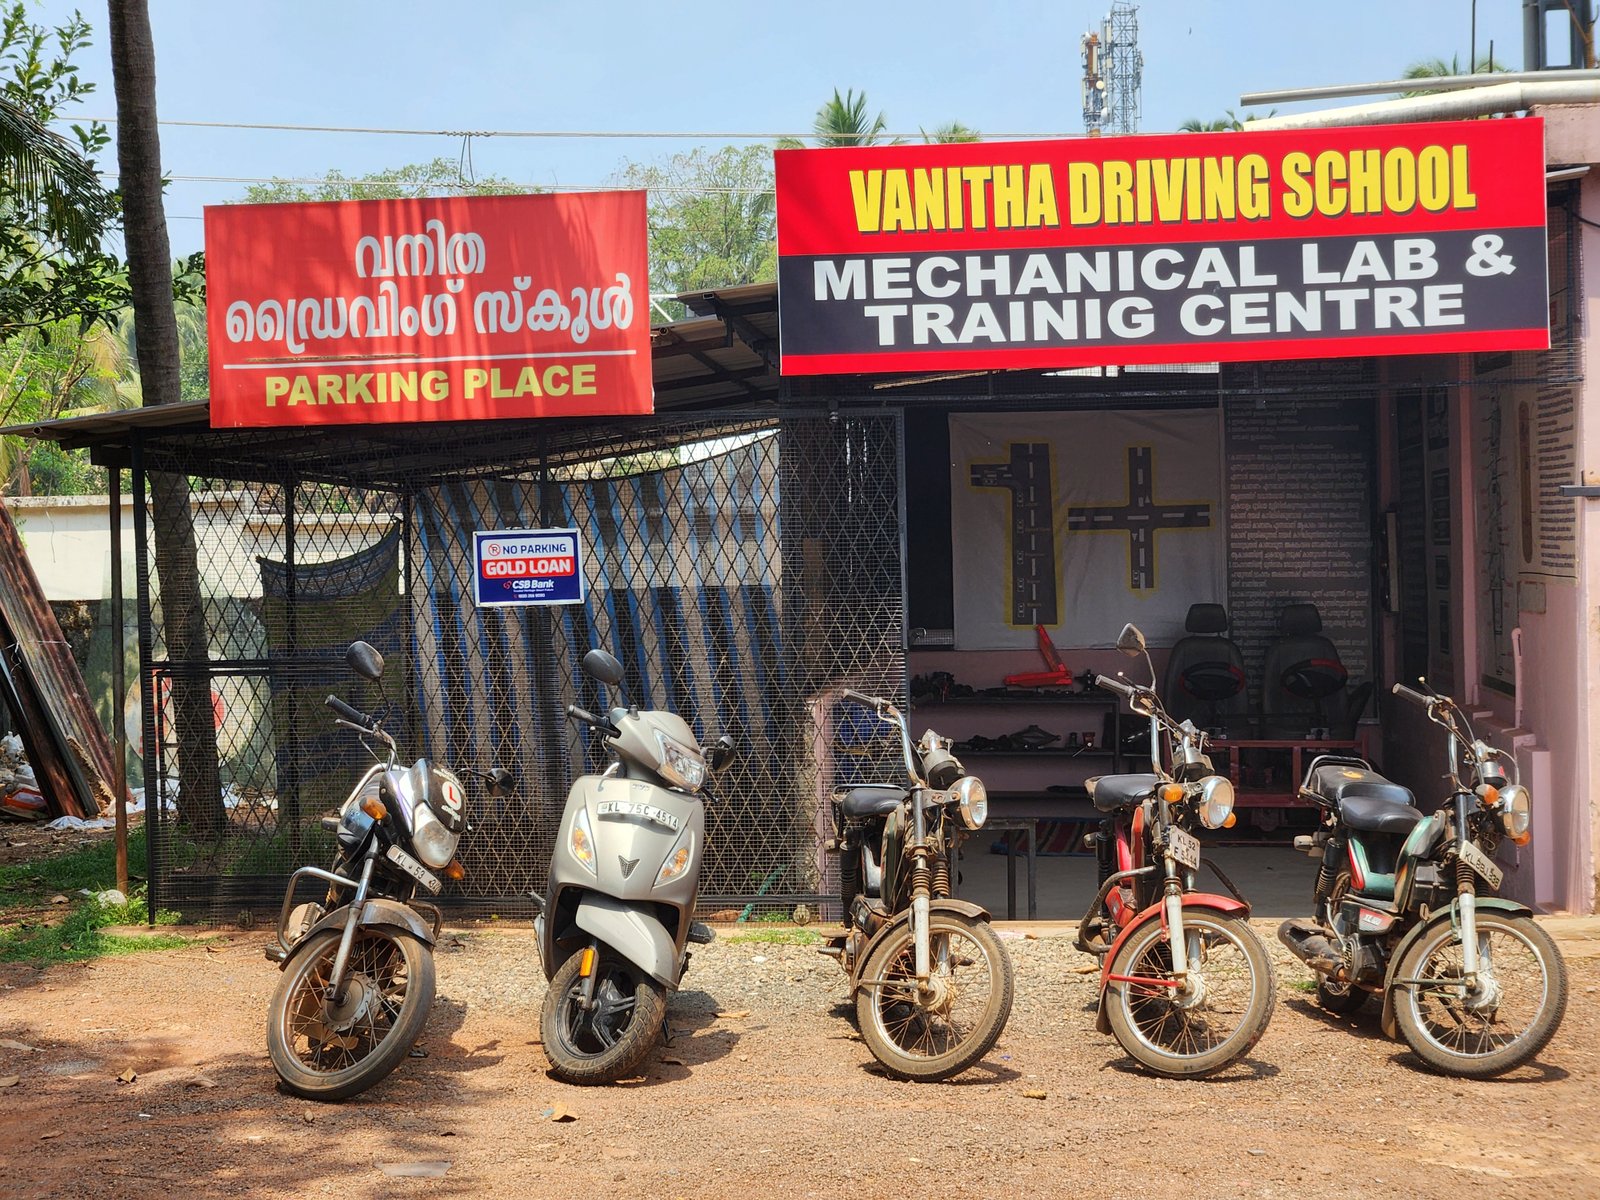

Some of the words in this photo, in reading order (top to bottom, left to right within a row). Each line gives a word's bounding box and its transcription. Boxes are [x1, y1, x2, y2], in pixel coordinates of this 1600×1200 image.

[849, 163, 1060, 234] VANITHA
[1068, 154, 1272, 226] DRIVING
[1281, 145, 1478, 219] SCHOOL
[355, 219, 487, 279] വനിത
[814, 246, 1278, 302] MECHANICAL
[1302, 239, 1439, 285] LAB
[1465, 234, 1518, 278] &
[473, 273, 635, 345] സ്കൂൾ
[863, 297, 1156, 348] TRAINIG
[1179, 284, 1466, 337] CENTRE
[265, 370, 450, 408] PARKING
[463, 364, 598, 400] PLACE
[485, 560, 527, 576] GOLD
[529, 558, 571, 575] LOAN
[502, 545, 518, 555] NO
[520, 543, 567, 554] PARKING
[512, 580, 531, 589] CSB
[531, 579, 554, 589] Bank
